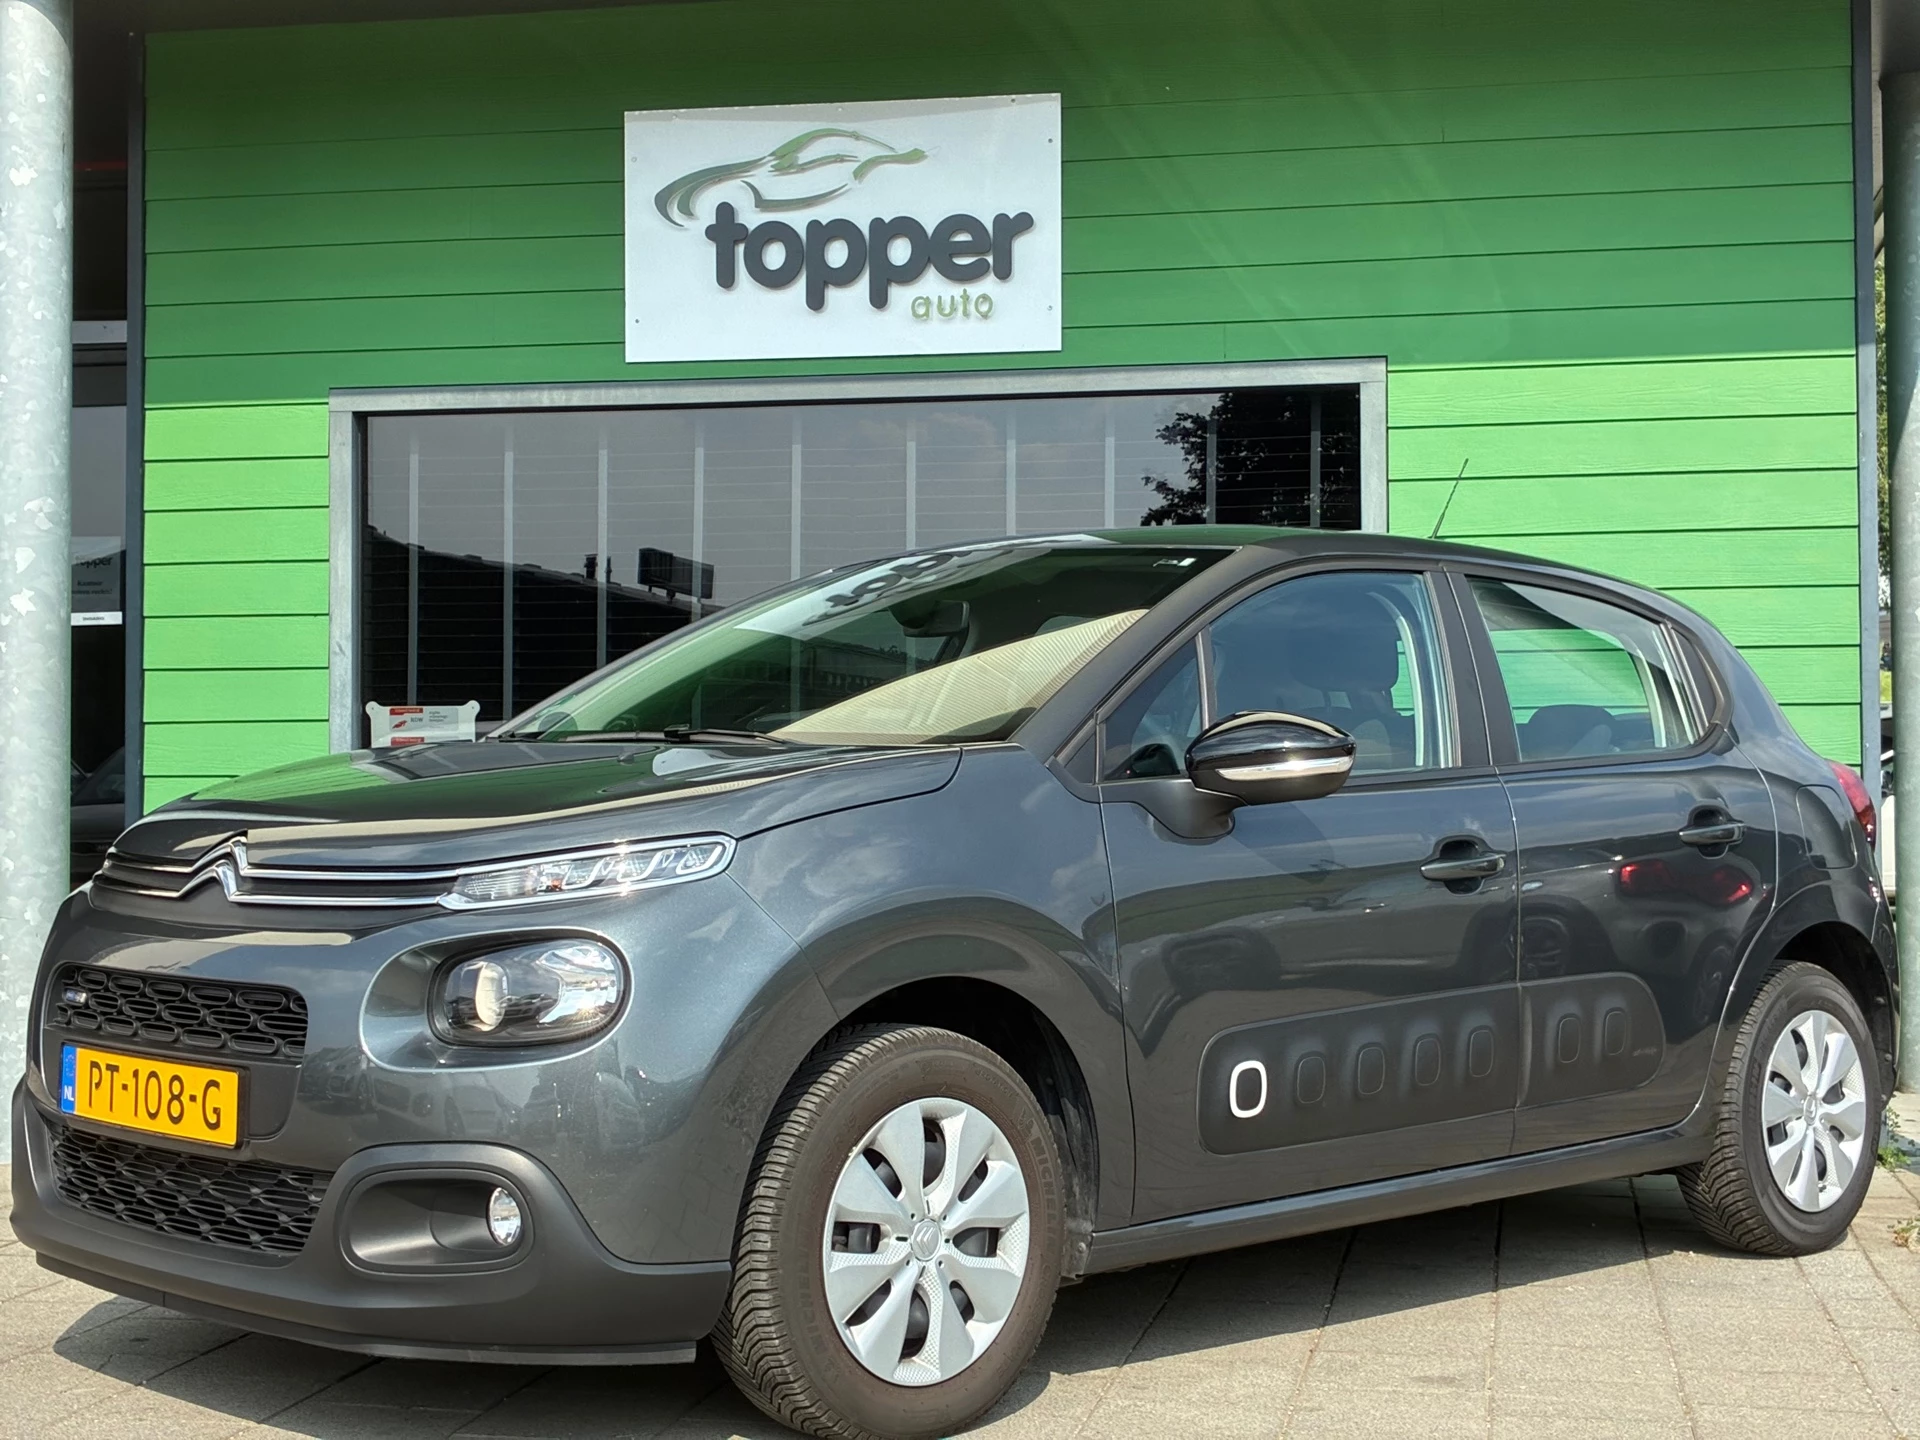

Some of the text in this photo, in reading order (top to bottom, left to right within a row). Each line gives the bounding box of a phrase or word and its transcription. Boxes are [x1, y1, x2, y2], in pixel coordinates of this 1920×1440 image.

[705, 201, 1035, 312] topper
[910, 288, 995, 320] auto
[63, 1060, 222, 1131] NL PT-108-G
